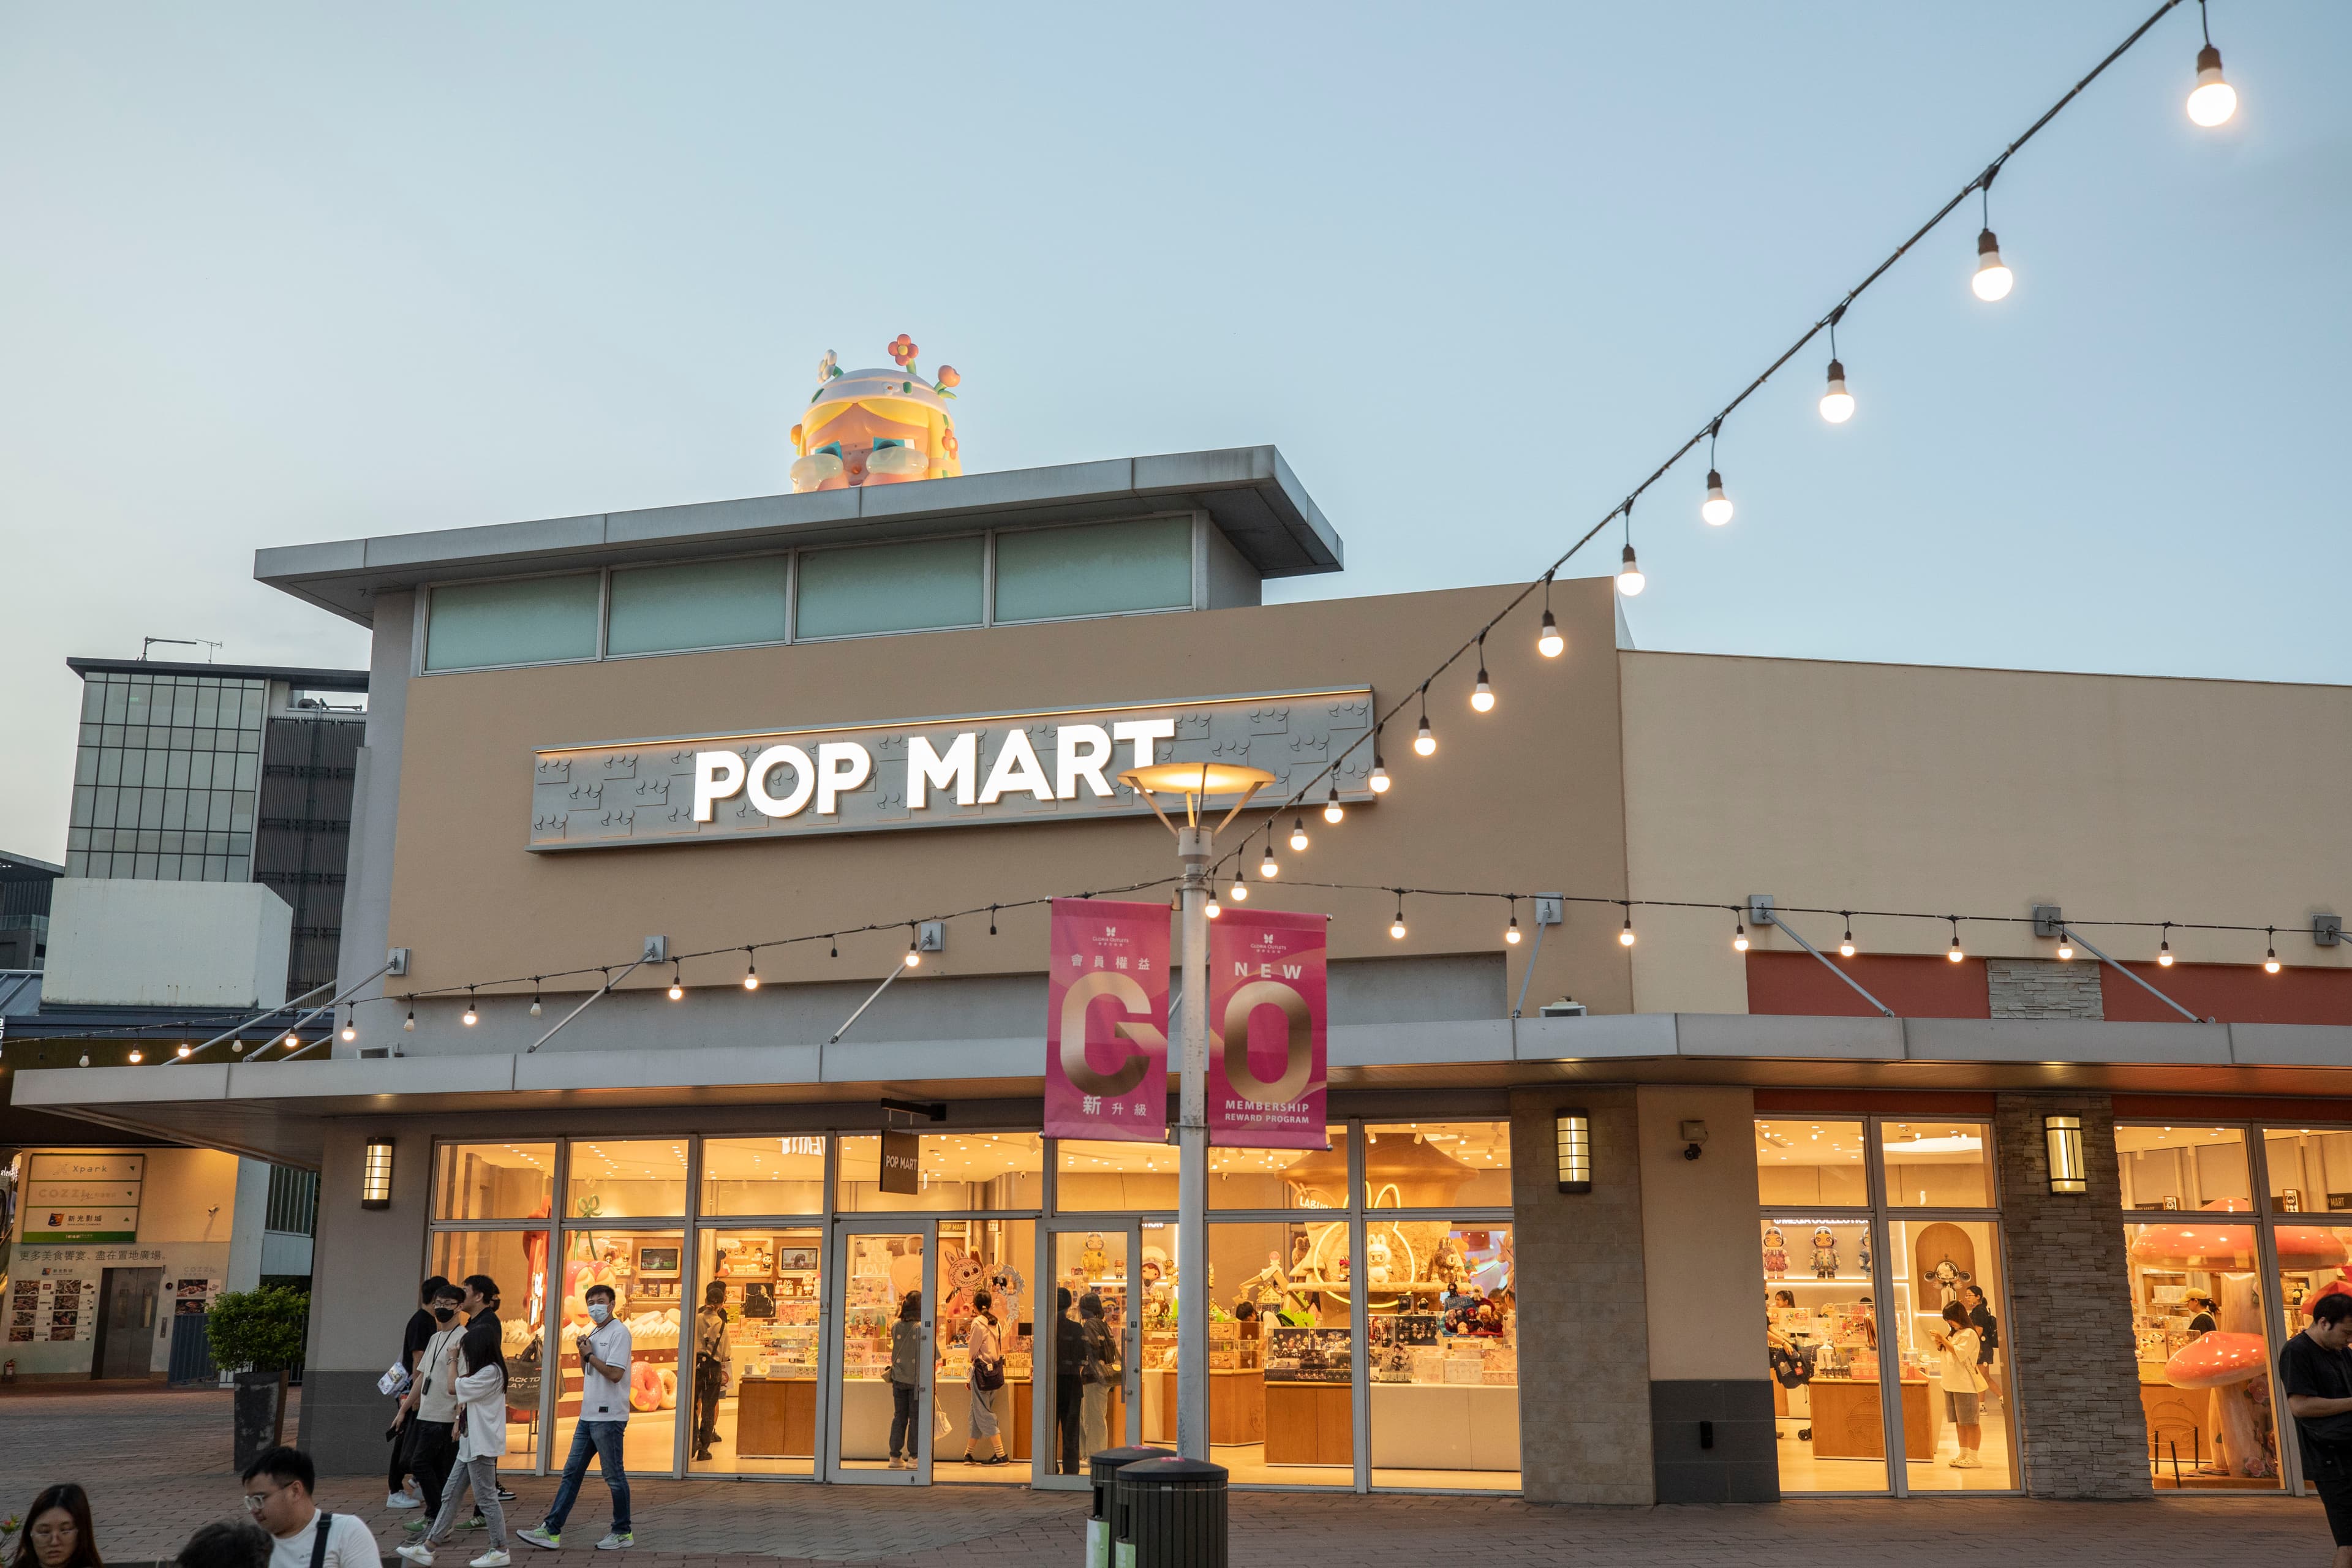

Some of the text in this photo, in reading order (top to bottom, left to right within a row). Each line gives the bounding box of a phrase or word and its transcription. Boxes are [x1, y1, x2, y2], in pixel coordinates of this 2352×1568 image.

[693, 718, 1175, 823] POP MART
[1071, 954, 1150, 970] 會員權益
[1235, 962, 1302, 979] NEW
[1082, 1095, 1147, 1116] 新升級
[1226, 1100, 1310, 1112] MEMBERSHIP
[1266, 1115, 1310, 1124] PROGRAM
[886, 1155, 918, 1170] POP MART
[1299, 1196, 1333, 1209] LABU
[2331, 1197, 2345, 1207] MART
